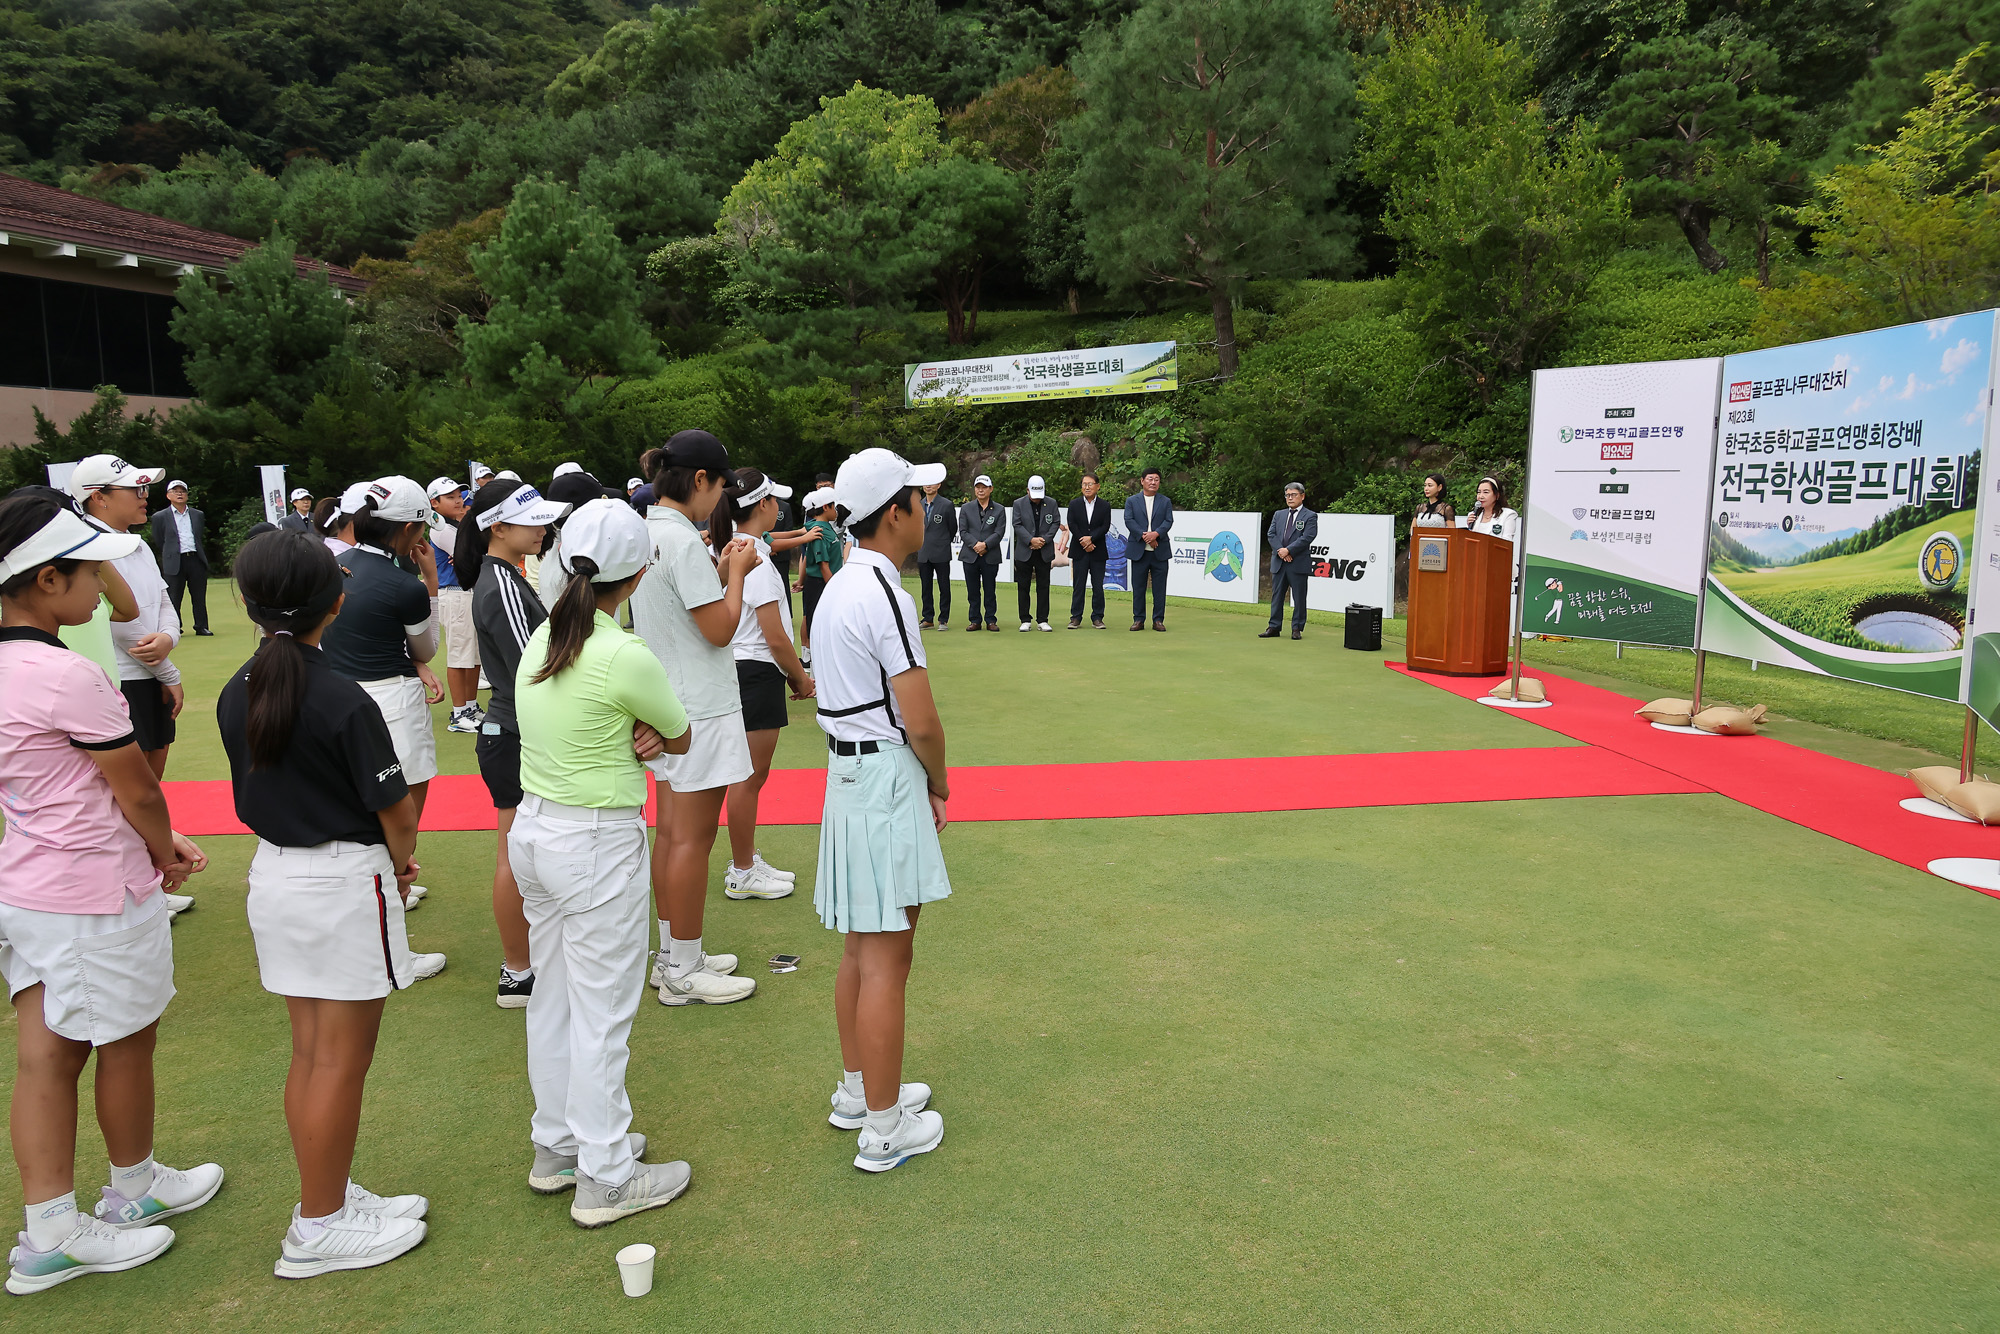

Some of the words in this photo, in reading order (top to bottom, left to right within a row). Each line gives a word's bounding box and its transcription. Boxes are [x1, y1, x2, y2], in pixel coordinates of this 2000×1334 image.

[937, 364, 993, 376] 골프꿈나무대잔치
[1023, 358, 1124, 380] 전국학생골프대회
[1729, 381, 1752, 403] 일요신문
[1751, 369, 1848, 399] 골프꿈나무대잔치
[1620, 409, 1633, 417] 주관
[1727, 408, 1756, 424] 제23회
[1574, 426, 1684, 440] 한국초등학교골프연맹
[1725, 419, 1923, 455] 한국초등학교골프연맹회장배
[1602, 444, 1633, 459] 일요신문
[1720, 454, 1966, 508] 전국학생골프대회
[417, 509, 425, 518] FJ
[1589, 509, 1655, 521] 대한골프협회
[1590, 531, 1652, 545] 보성컨트리클럽
[1173, 547, 1206, 565] 스파클
[1310, 545, 1330, 556] BIG
[1567, 592, 1584, 608] 꿈을
[1585, 589, 1607, 604] 향한
[1577, 605, 1607, 622] 미래를
[1608, 605, 1628, 616] 여는
[1630, 601, 1653, 614] 도전!
[883, 1142, 890, 1151] FJ
